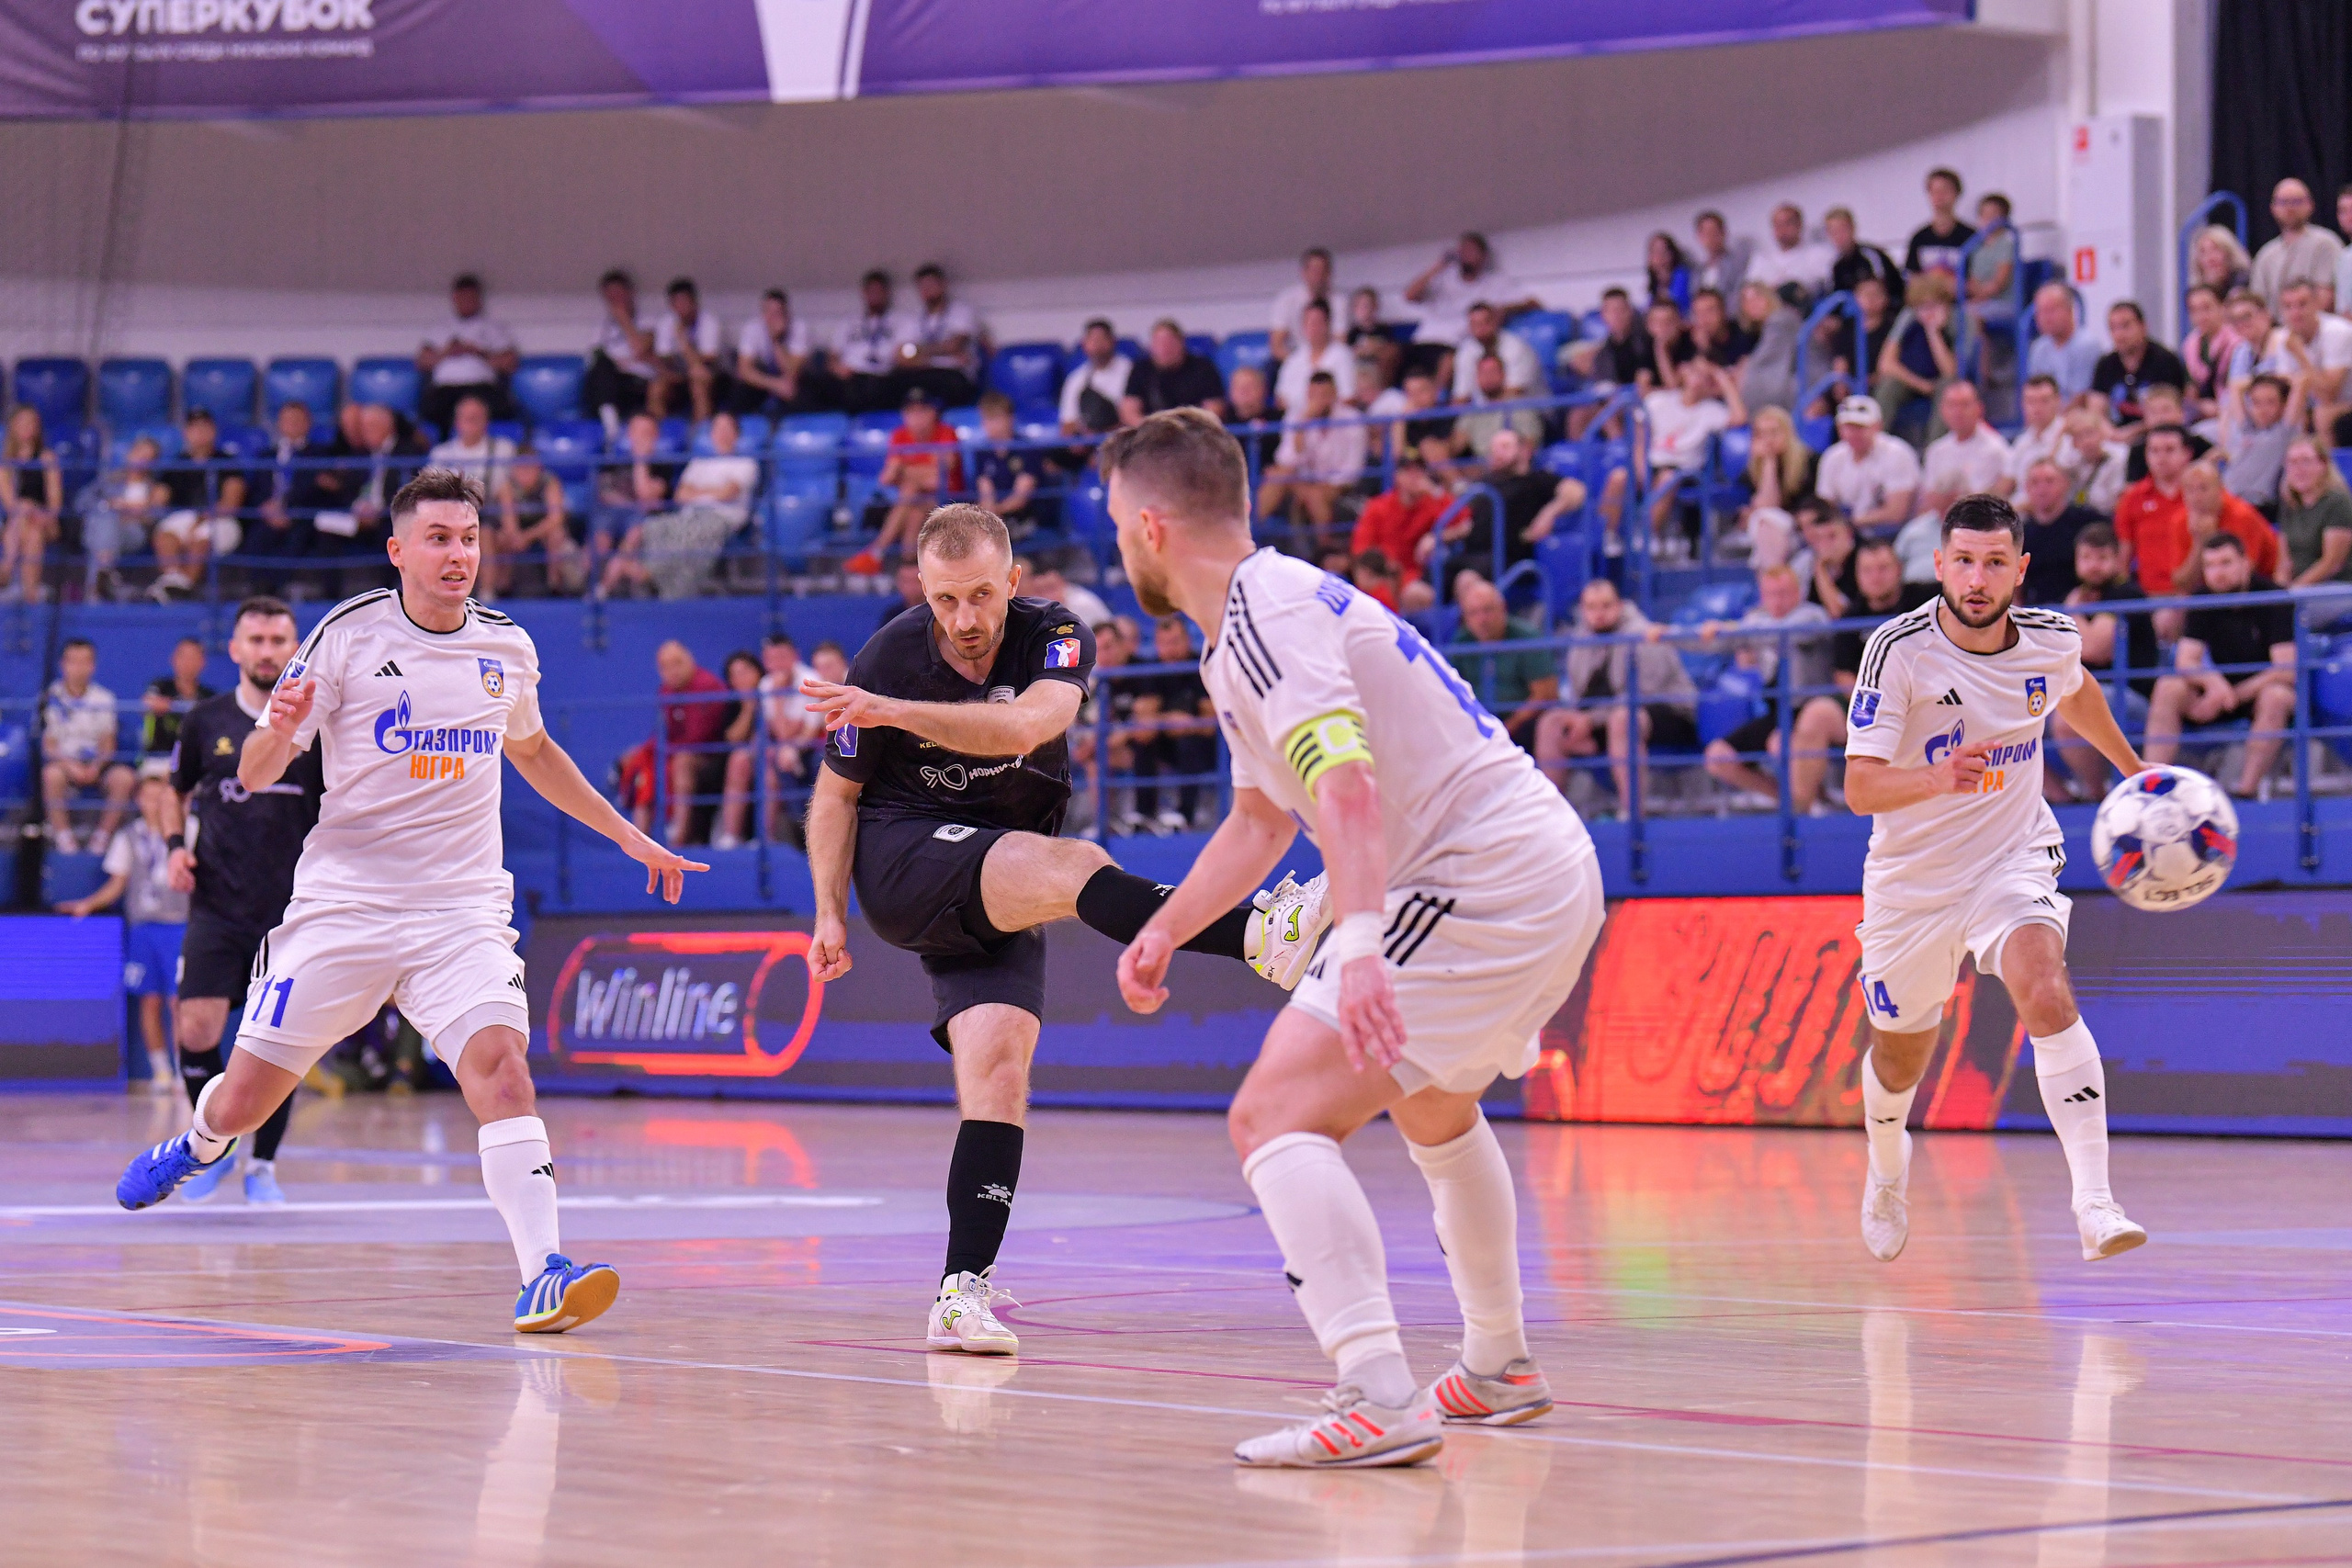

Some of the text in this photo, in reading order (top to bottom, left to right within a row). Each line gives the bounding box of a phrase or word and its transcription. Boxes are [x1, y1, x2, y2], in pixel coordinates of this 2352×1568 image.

[75, 0, 375, 35] СУПЕРКУБОК
[413, 728, 497, 755] ГАЗПРОМ
[1317, 717, 1358, 755] C
[1985, 738, 2036, 767] ПРОМ
[410, 754, 465, 780] ЮГРА
[251, 975, 294, 1029] 11
[573, 966, 739, 1042] Winline
[1860, 975, 1899, 1019] 14
